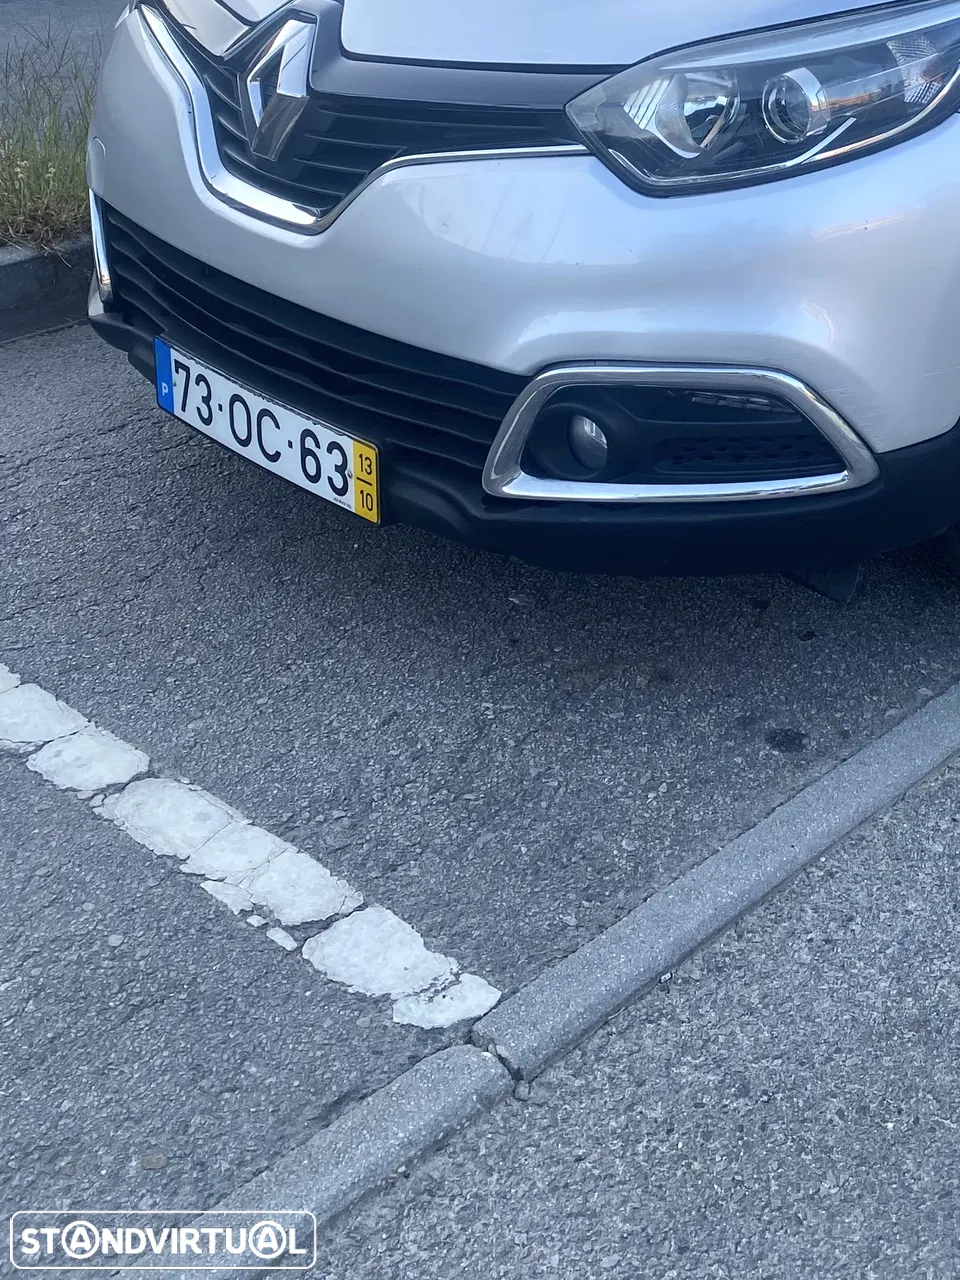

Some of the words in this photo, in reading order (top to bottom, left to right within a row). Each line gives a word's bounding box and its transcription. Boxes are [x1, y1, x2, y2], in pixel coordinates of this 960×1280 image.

[161, 382, 169, 396] P
[358, 453, 373, 476] 13
[359, 489, 374, 512] 10
